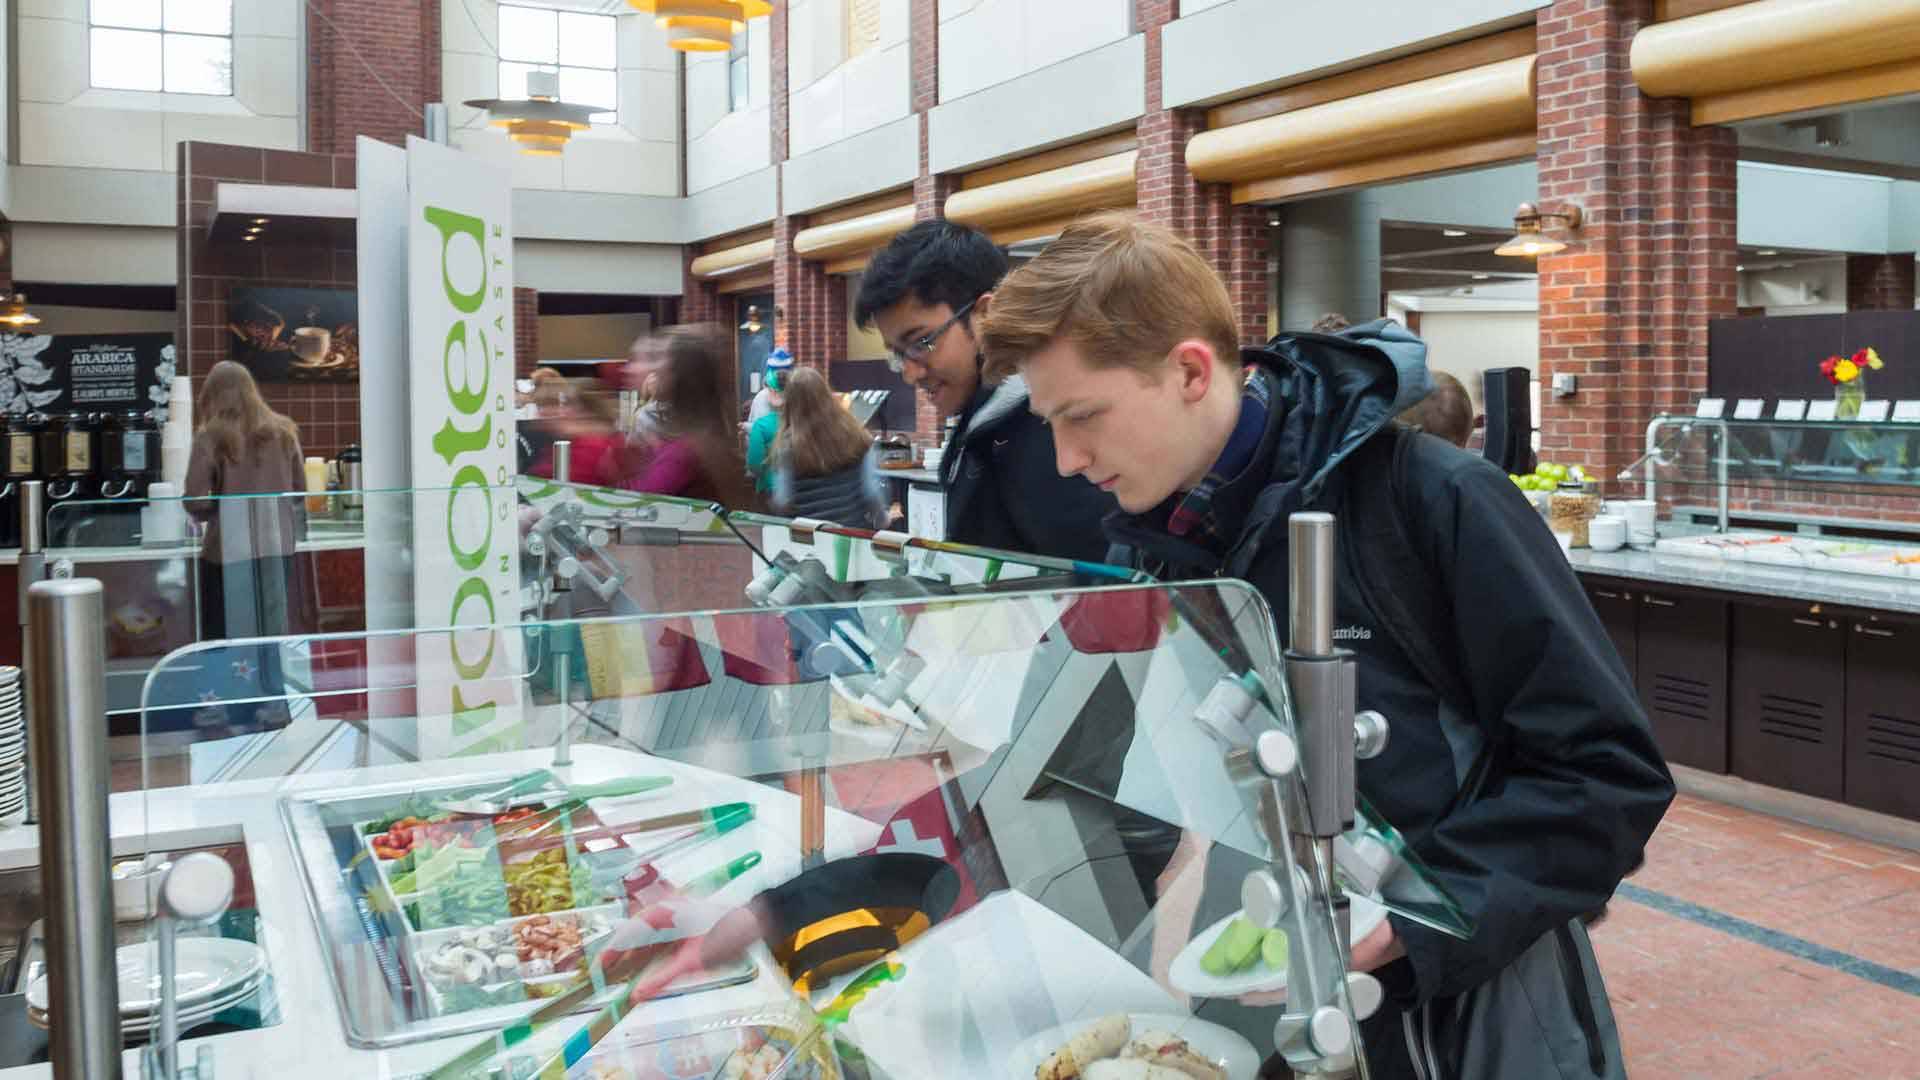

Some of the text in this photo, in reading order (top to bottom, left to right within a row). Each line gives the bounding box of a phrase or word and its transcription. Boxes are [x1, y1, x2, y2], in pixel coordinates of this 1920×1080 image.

[72, 352, 136, 364] ARABICA
[493, 223, 510, 596] IN GOOD TASTE
[424, 205, 497, 736] rooted
[1332, 625, 1371, 639] umbia
